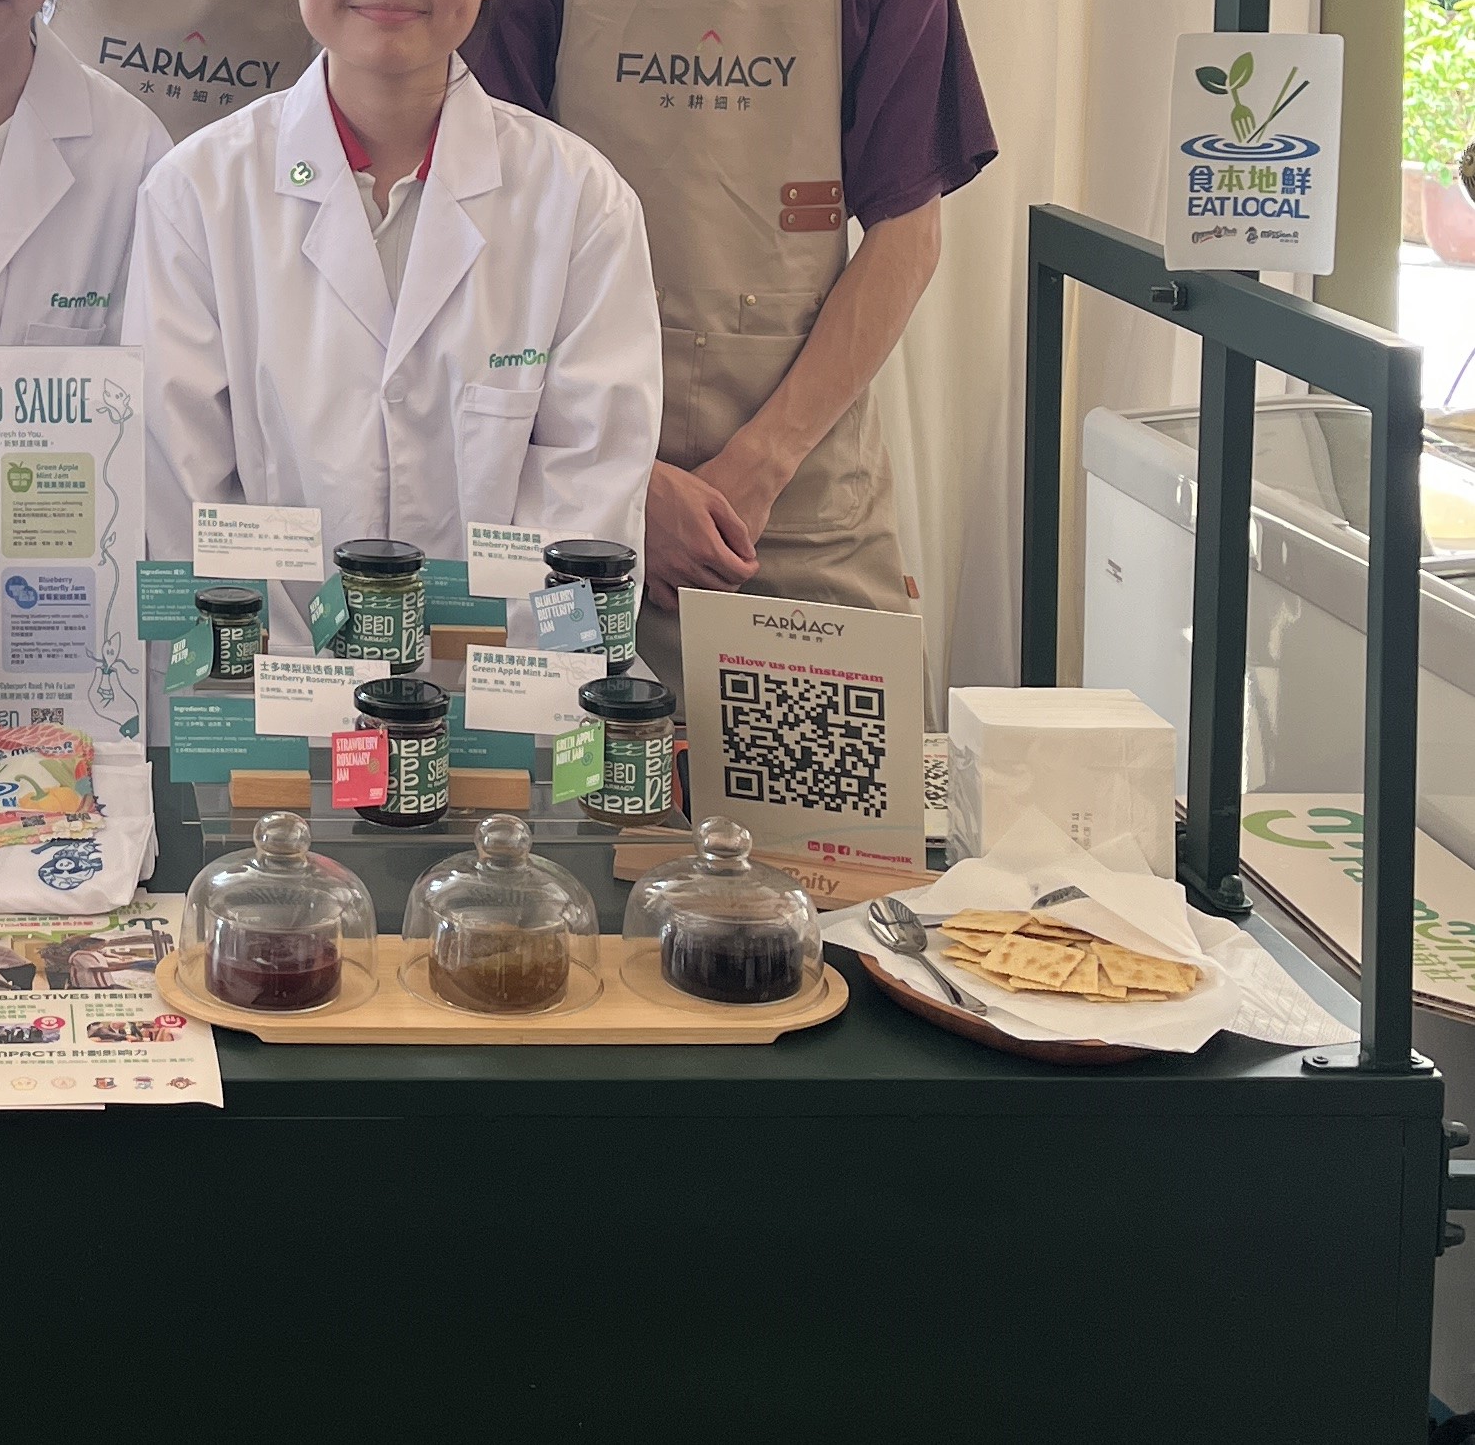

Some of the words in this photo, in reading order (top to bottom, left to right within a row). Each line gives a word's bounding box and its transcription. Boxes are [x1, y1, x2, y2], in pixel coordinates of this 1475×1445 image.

[99, 36, 280, 88] FARMACY
[616, 52, 796, 87] FARMACY
[139, 80, 234, 105] 水耕細作
[659, 94, 751, 111] 水耕細作
[1188, 165, 1312, 195] 食本地鮮
[14, 377, 93, 424] SAUCE
[219, 520, 237, 528] Basil
[353, 613, 395, 636] SEED
[752, 614, 845, 637] FARMACY
[260, 672, 304, 684] Strawberry
[306, 675, 345, 686] Rosemary
[472, 664, 497, 674] Green
[497, 666, 521, 676] Apple
[522, 667, 541, 677] Mint
[543, 669, 561, 679] Jam
[719, 654, 766, 668] Follow
[768, 660, 786, 670] us
[787, 662, 807, 673] on
[809, 664, 884, 684] instagram
